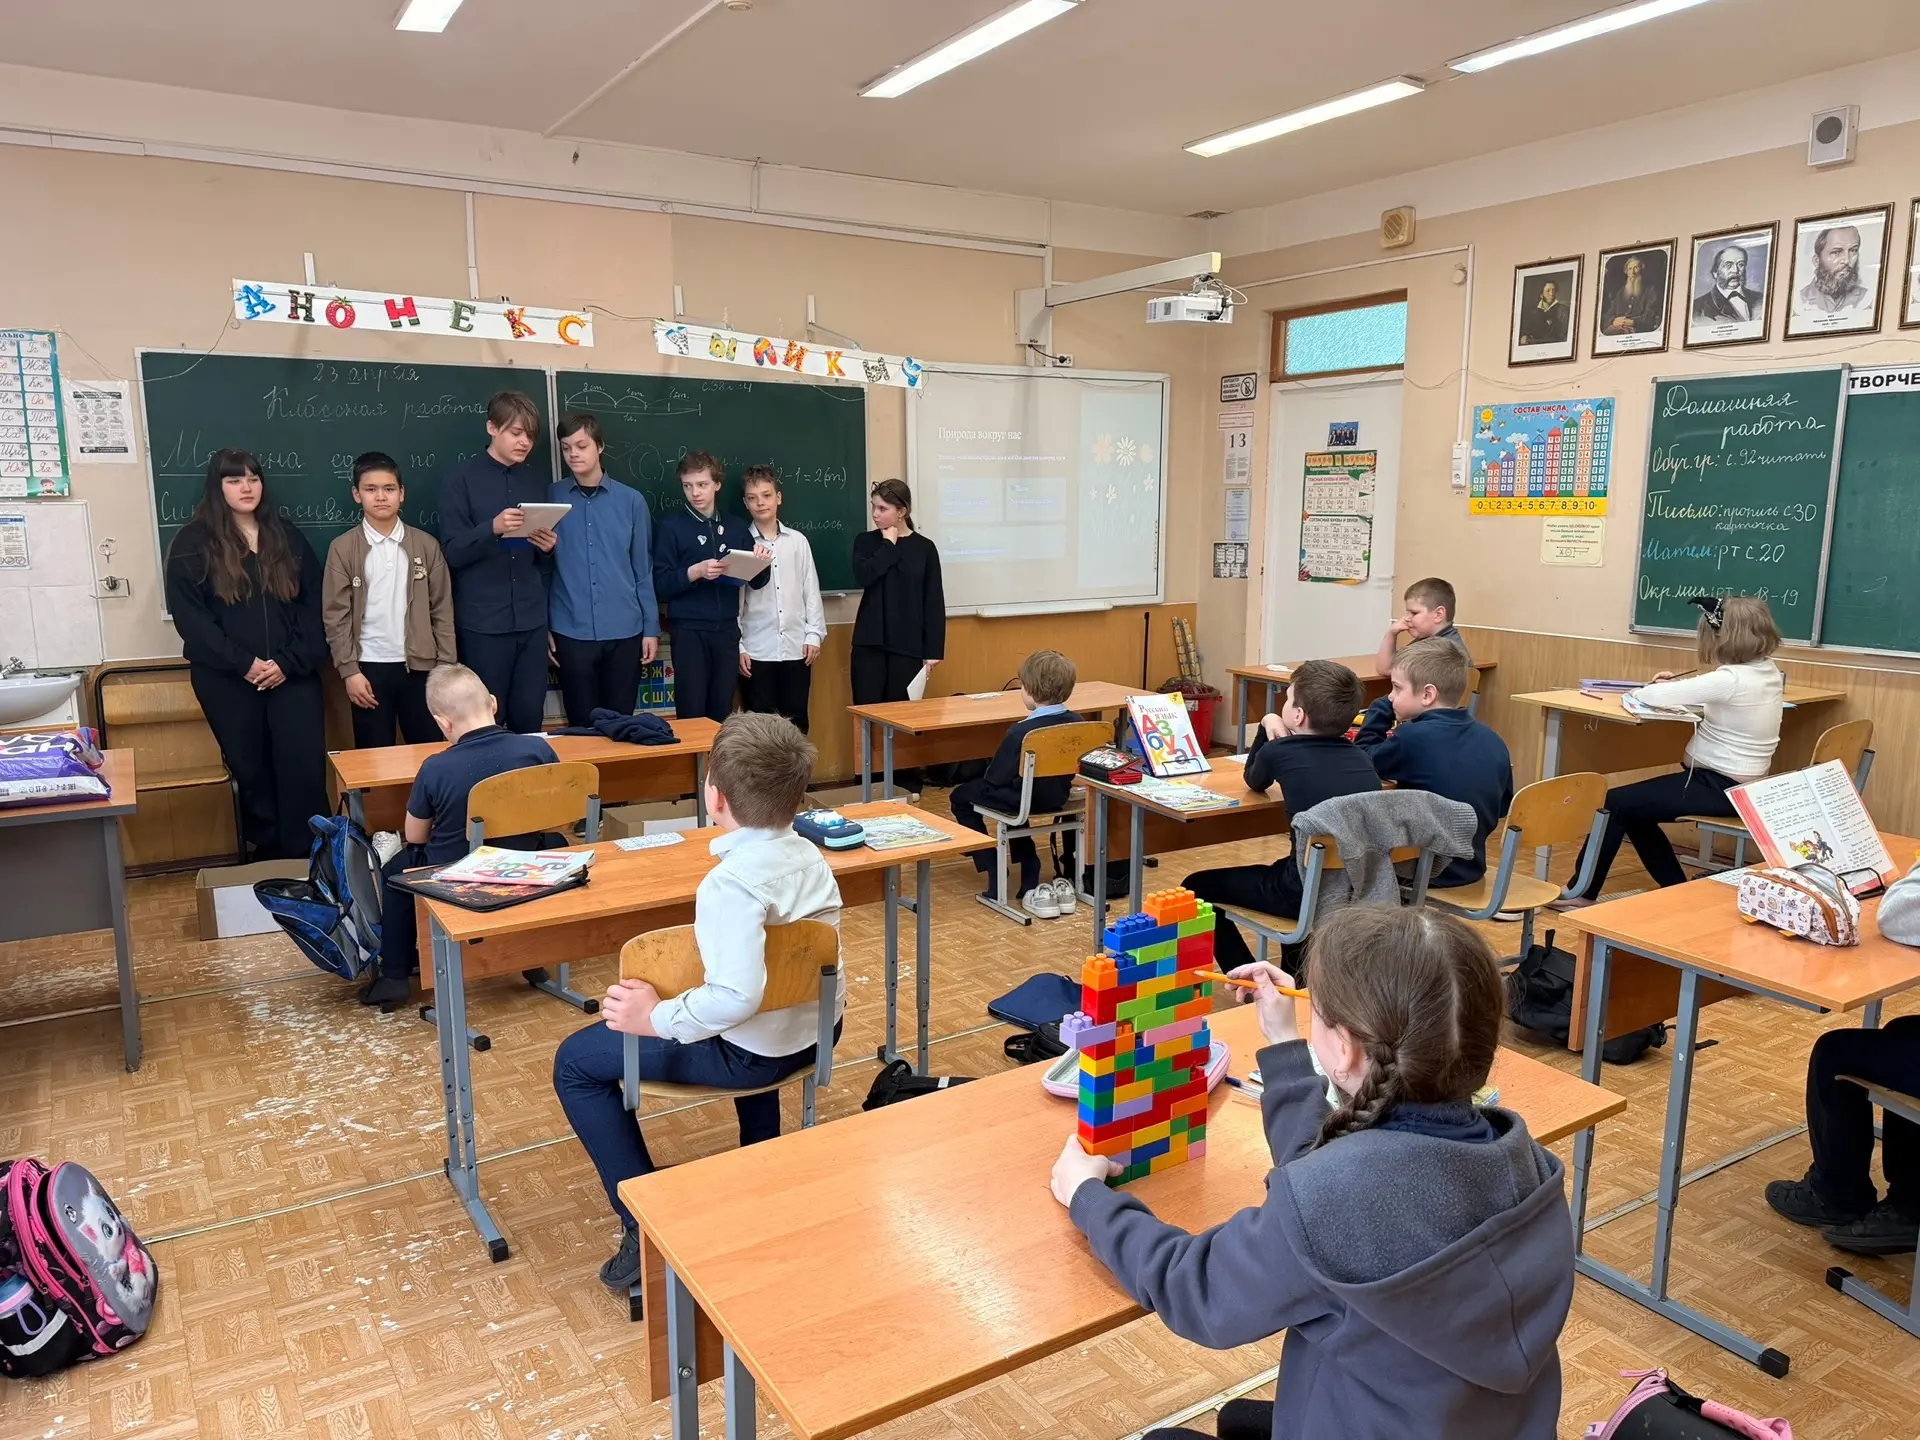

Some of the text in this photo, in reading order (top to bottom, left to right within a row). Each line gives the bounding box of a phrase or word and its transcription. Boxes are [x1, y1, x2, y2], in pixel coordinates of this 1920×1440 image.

[312, 362, 339, 383] 23
[1849, 372, 1920, 389] ТВОРЧЕ
[263, 385, 489, 430] Классная работа
[1662, 384, 1798, 417] Домашняя
[1513, 406, 1541, 414] СОСТАВ
[938, 427, 1022, 443] Природа вокруг нас
[1230, 432, 1247, 448] 13
[1720, 415, 1826, 450] работа
[1477, 501, 1595, 510] 0 1 2 3 4 5 6 7 8 9 10
[1647, 489, 1723, 519] Письмо:
[1723, 502, 1779, 524] пропись
[1715, 520, 1791, 535] карточка
[652, 666, 663, 678] Ж
[642, 692, 649, 704] С
[652, 692, 664, 703] Ш
